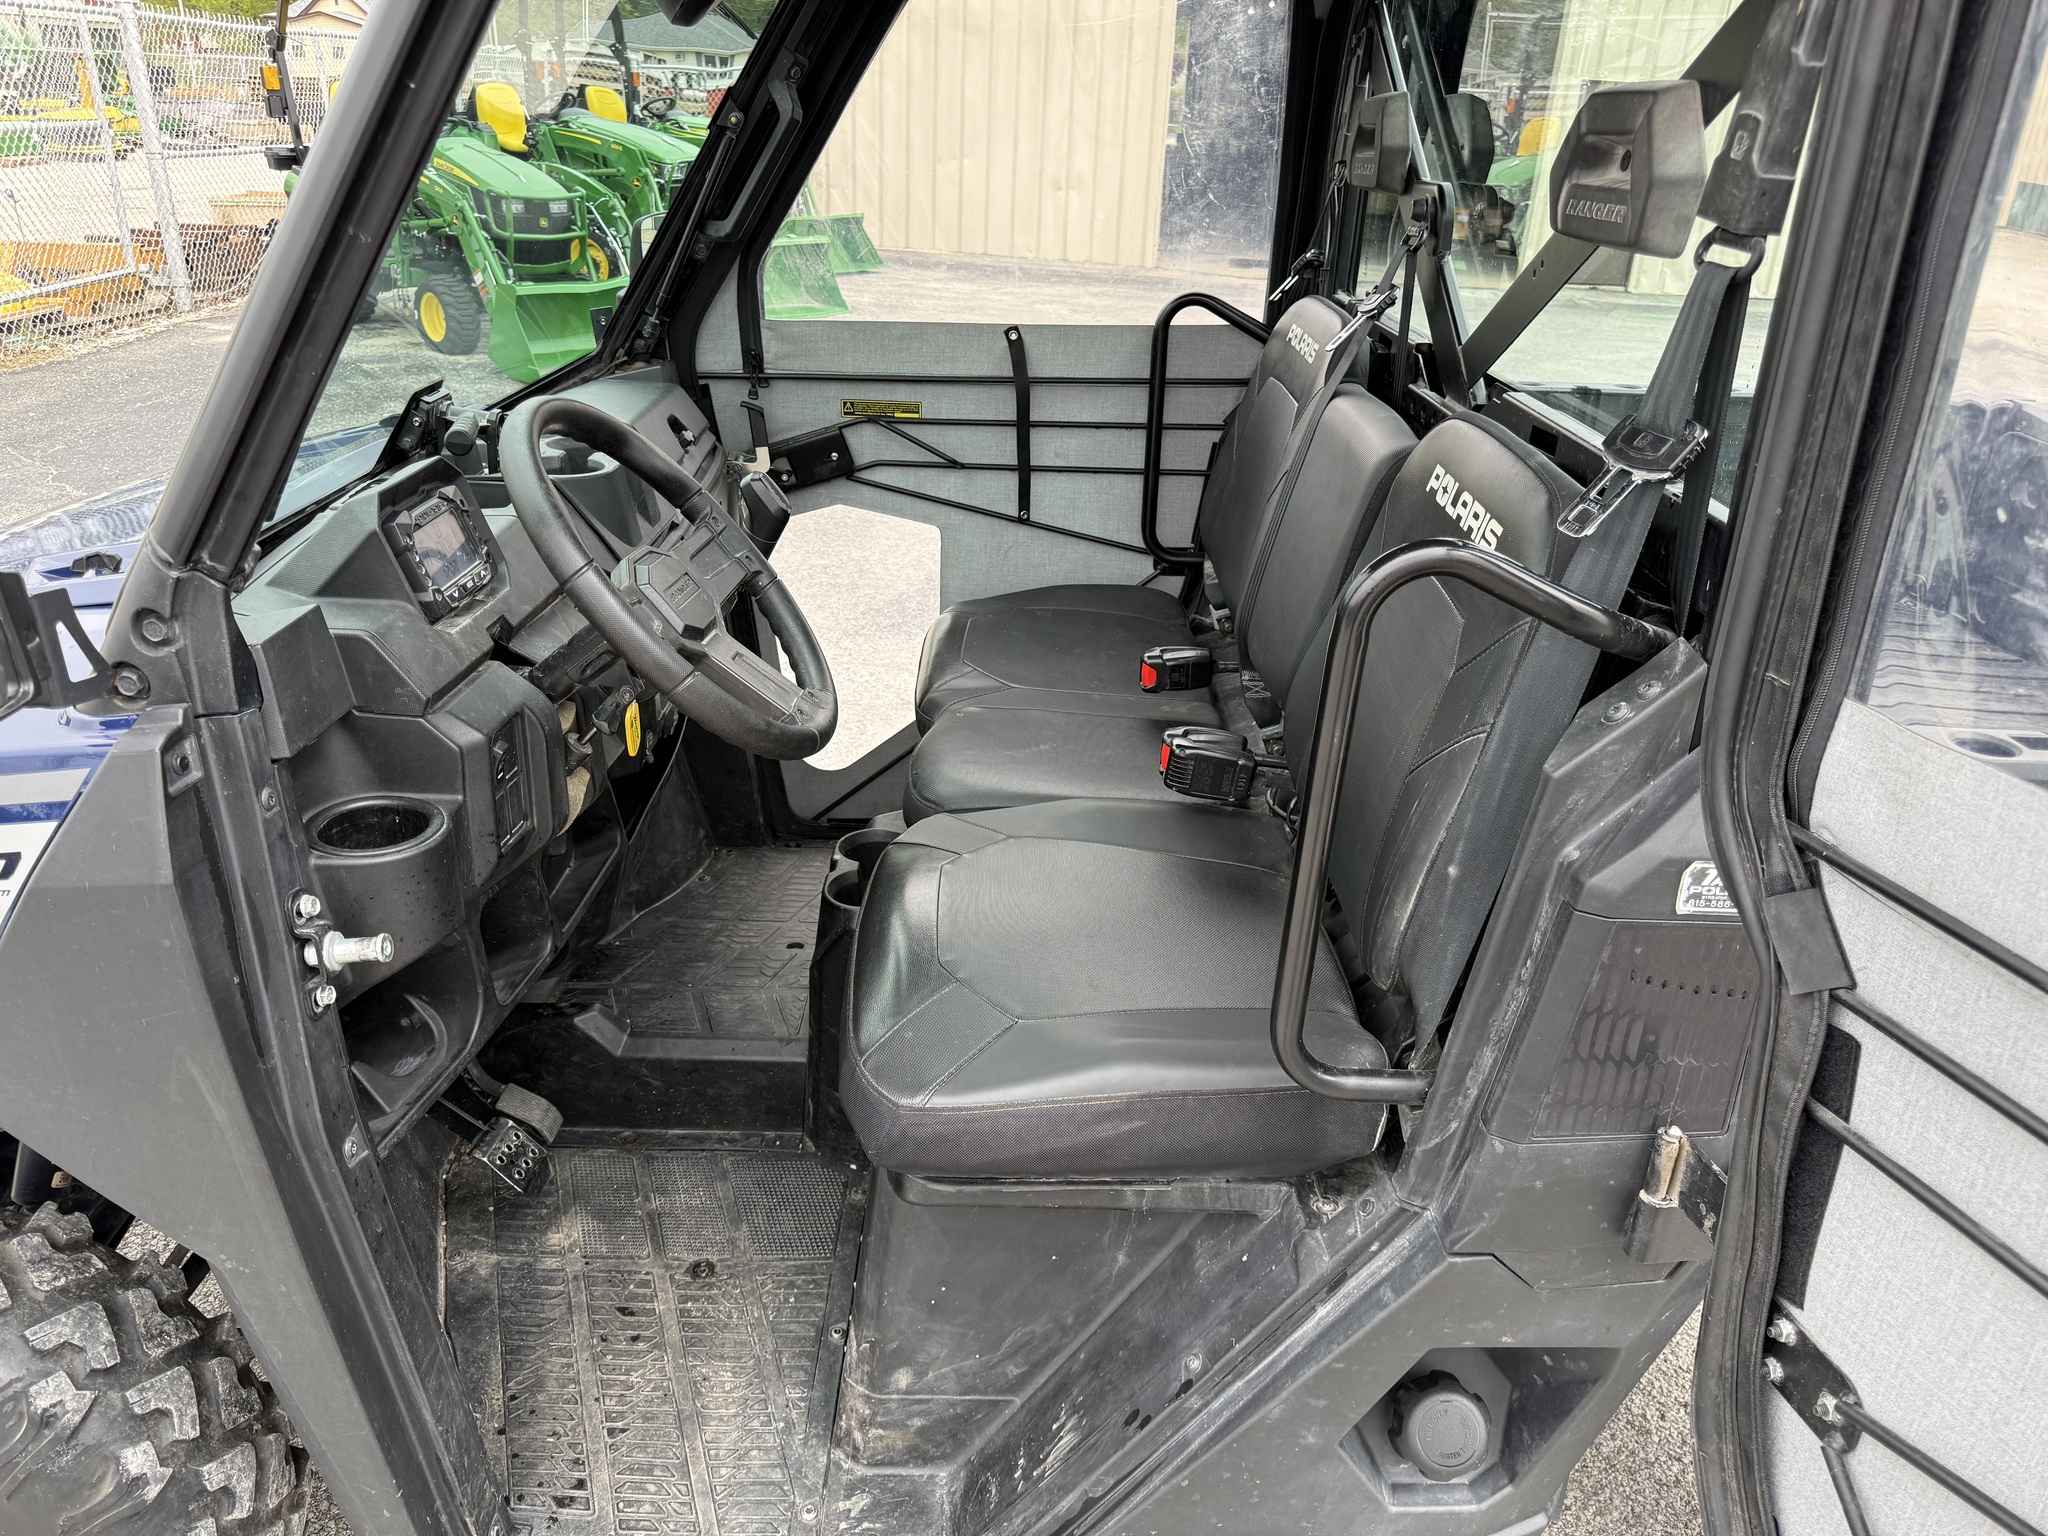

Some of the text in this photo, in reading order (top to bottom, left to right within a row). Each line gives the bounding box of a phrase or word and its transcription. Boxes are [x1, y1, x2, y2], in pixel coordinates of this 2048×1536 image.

[1565, 198, 1628, 224] RANGER
[1285, 323, 1320, 365] POLARIS
[1425, 463, 1504, 552] POLARIS
